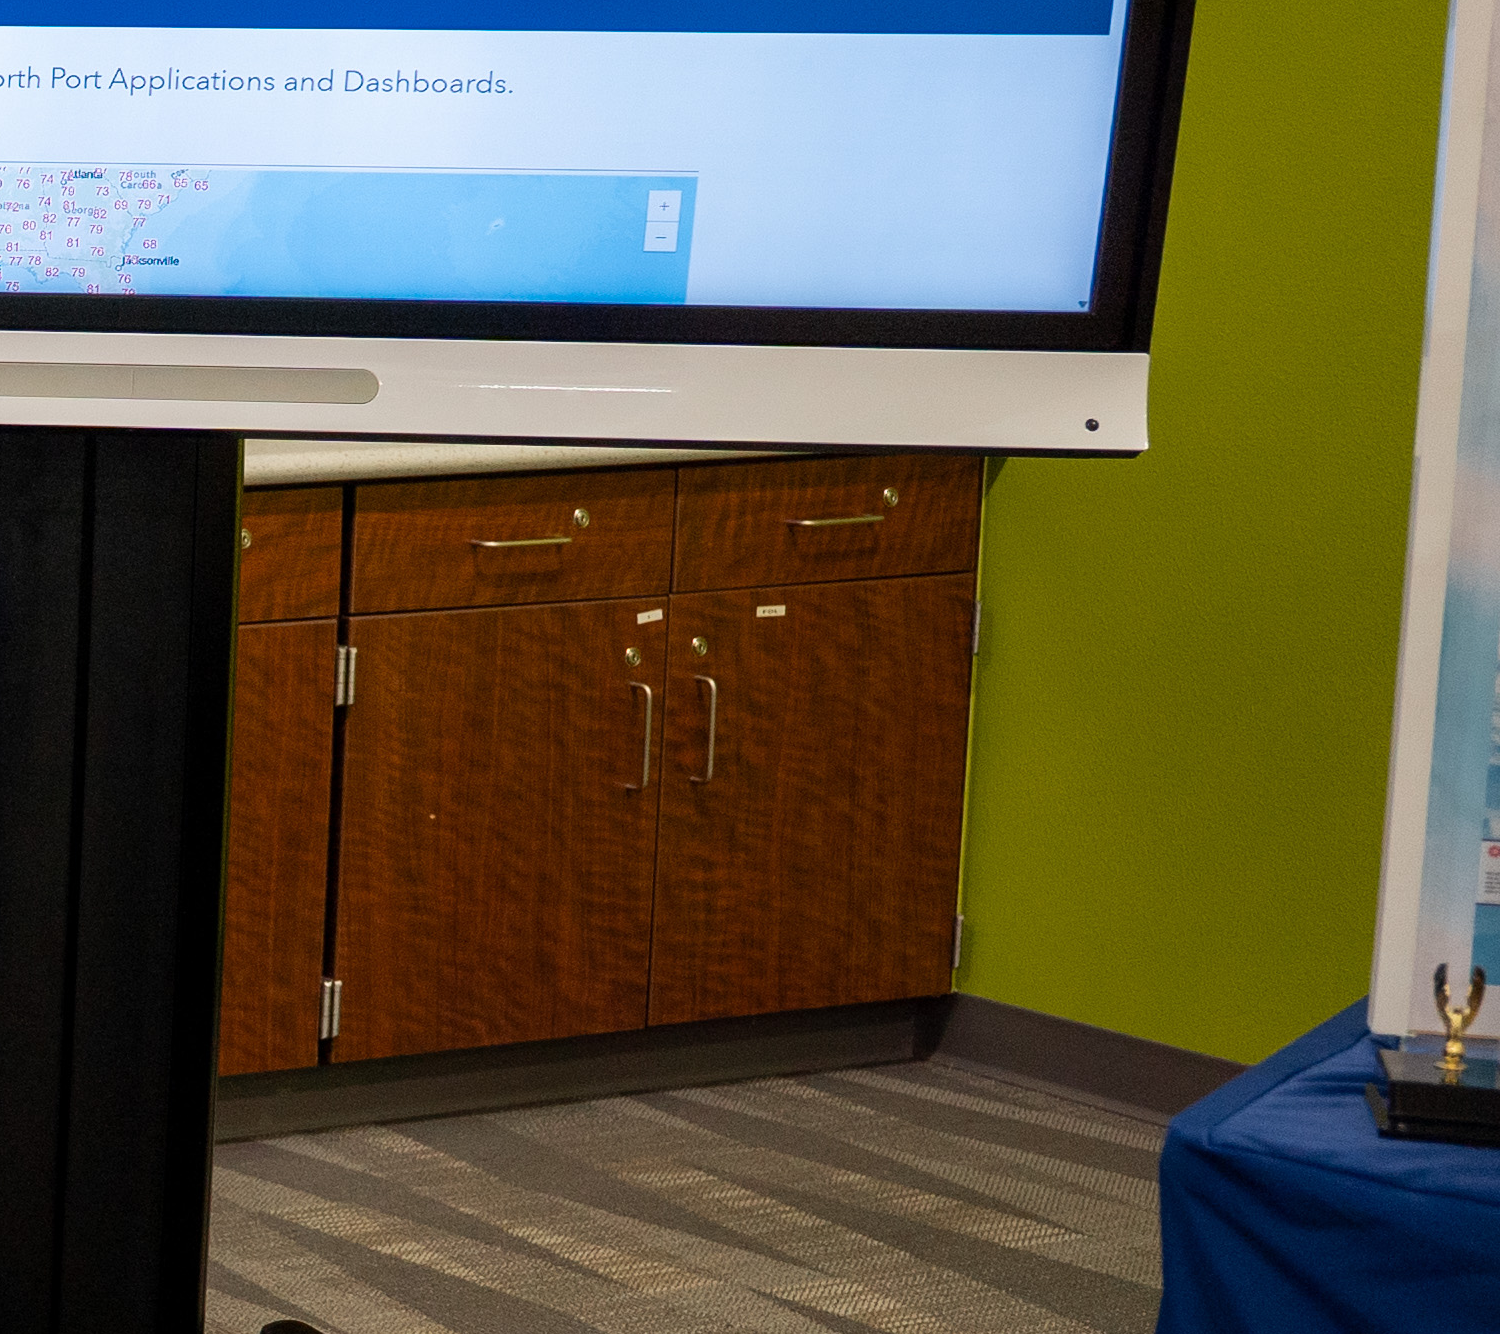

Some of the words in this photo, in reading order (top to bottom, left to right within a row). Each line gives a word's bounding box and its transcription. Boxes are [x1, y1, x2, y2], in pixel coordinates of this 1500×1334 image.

[51, 66, 103, 90] Port
[107, 66, 276, 96] Applications
[283, 67, 334, 92] and
[343, 69, 514, 94] Dashboards.
